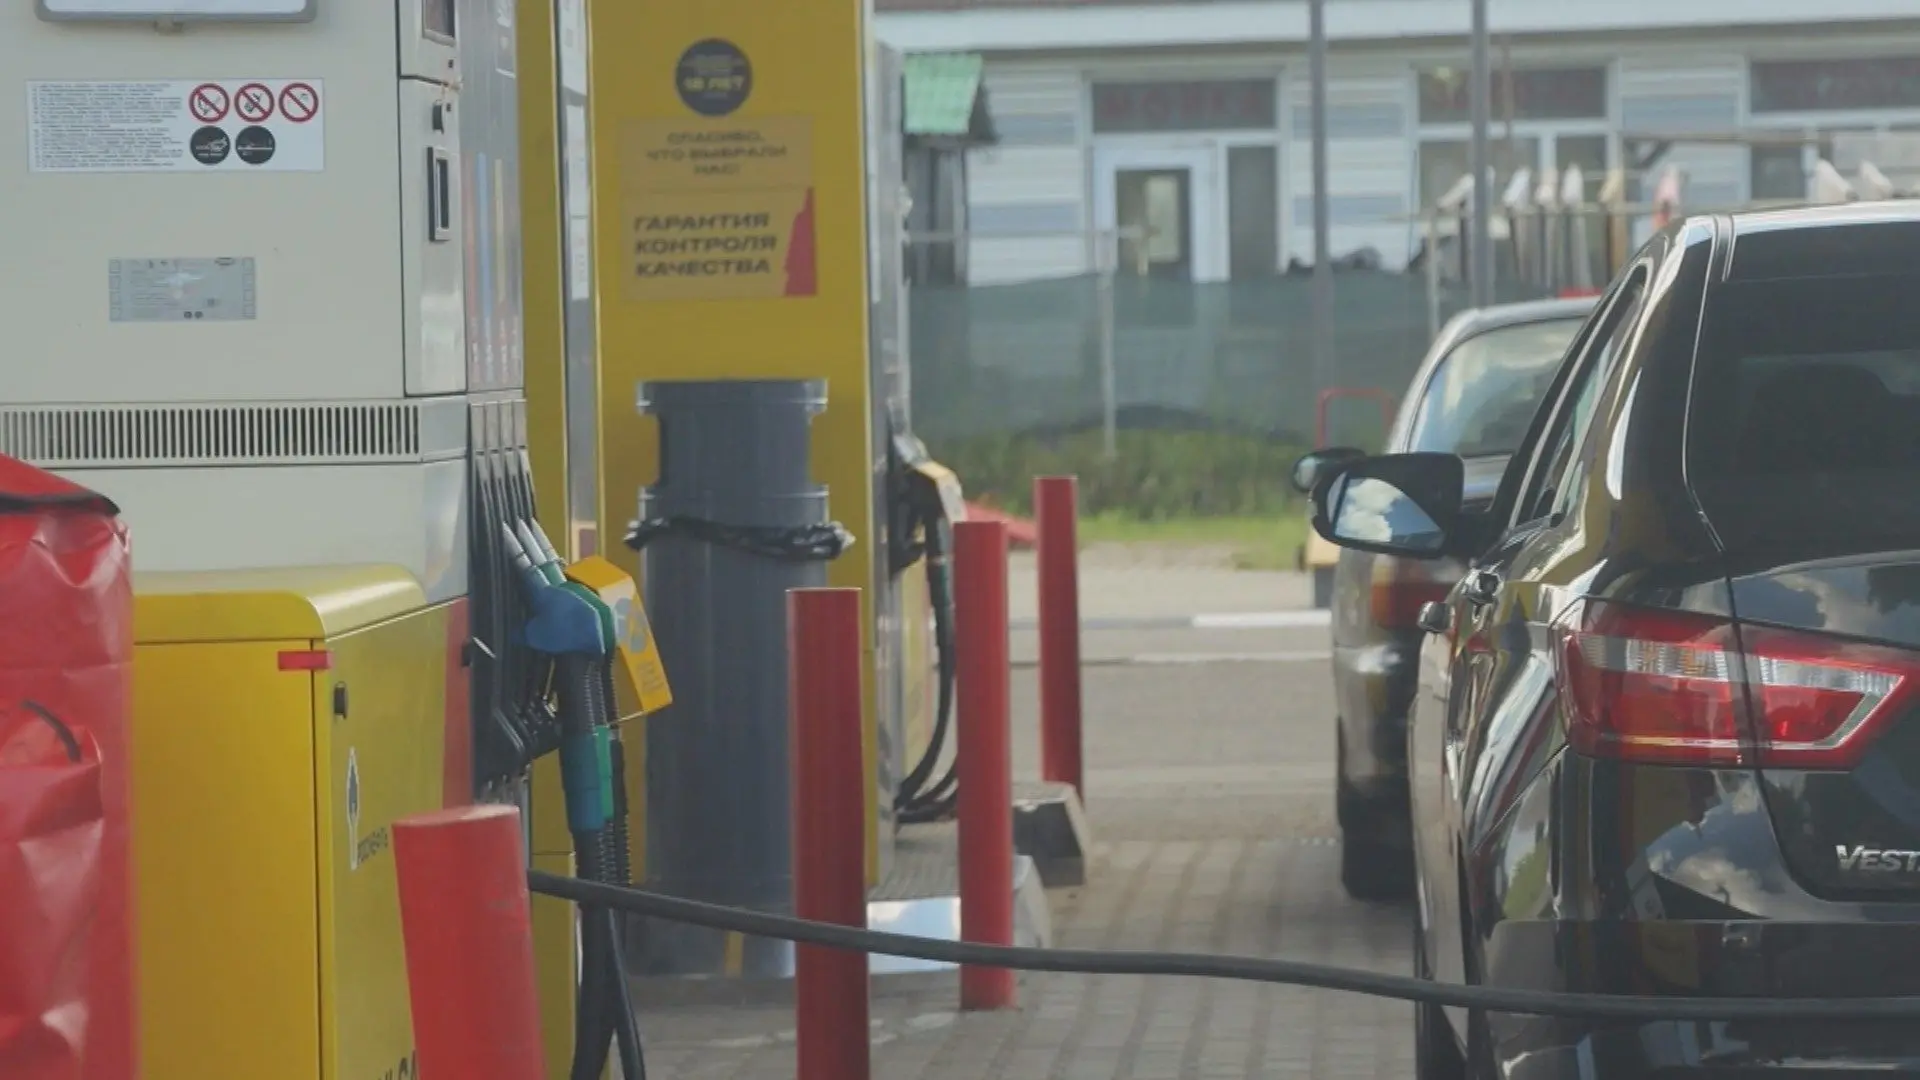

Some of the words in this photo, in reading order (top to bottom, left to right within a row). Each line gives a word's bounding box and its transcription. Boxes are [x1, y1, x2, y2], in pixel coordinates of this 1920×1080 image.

[634, 212, 769, 232] ГАРАНТИЯ
[635, 235, 776, 255] КОНТРОЛЯ
[635, 258, 770, 278] КАЧЕСТВА
[1836, 844, 1920, 873] VEST
